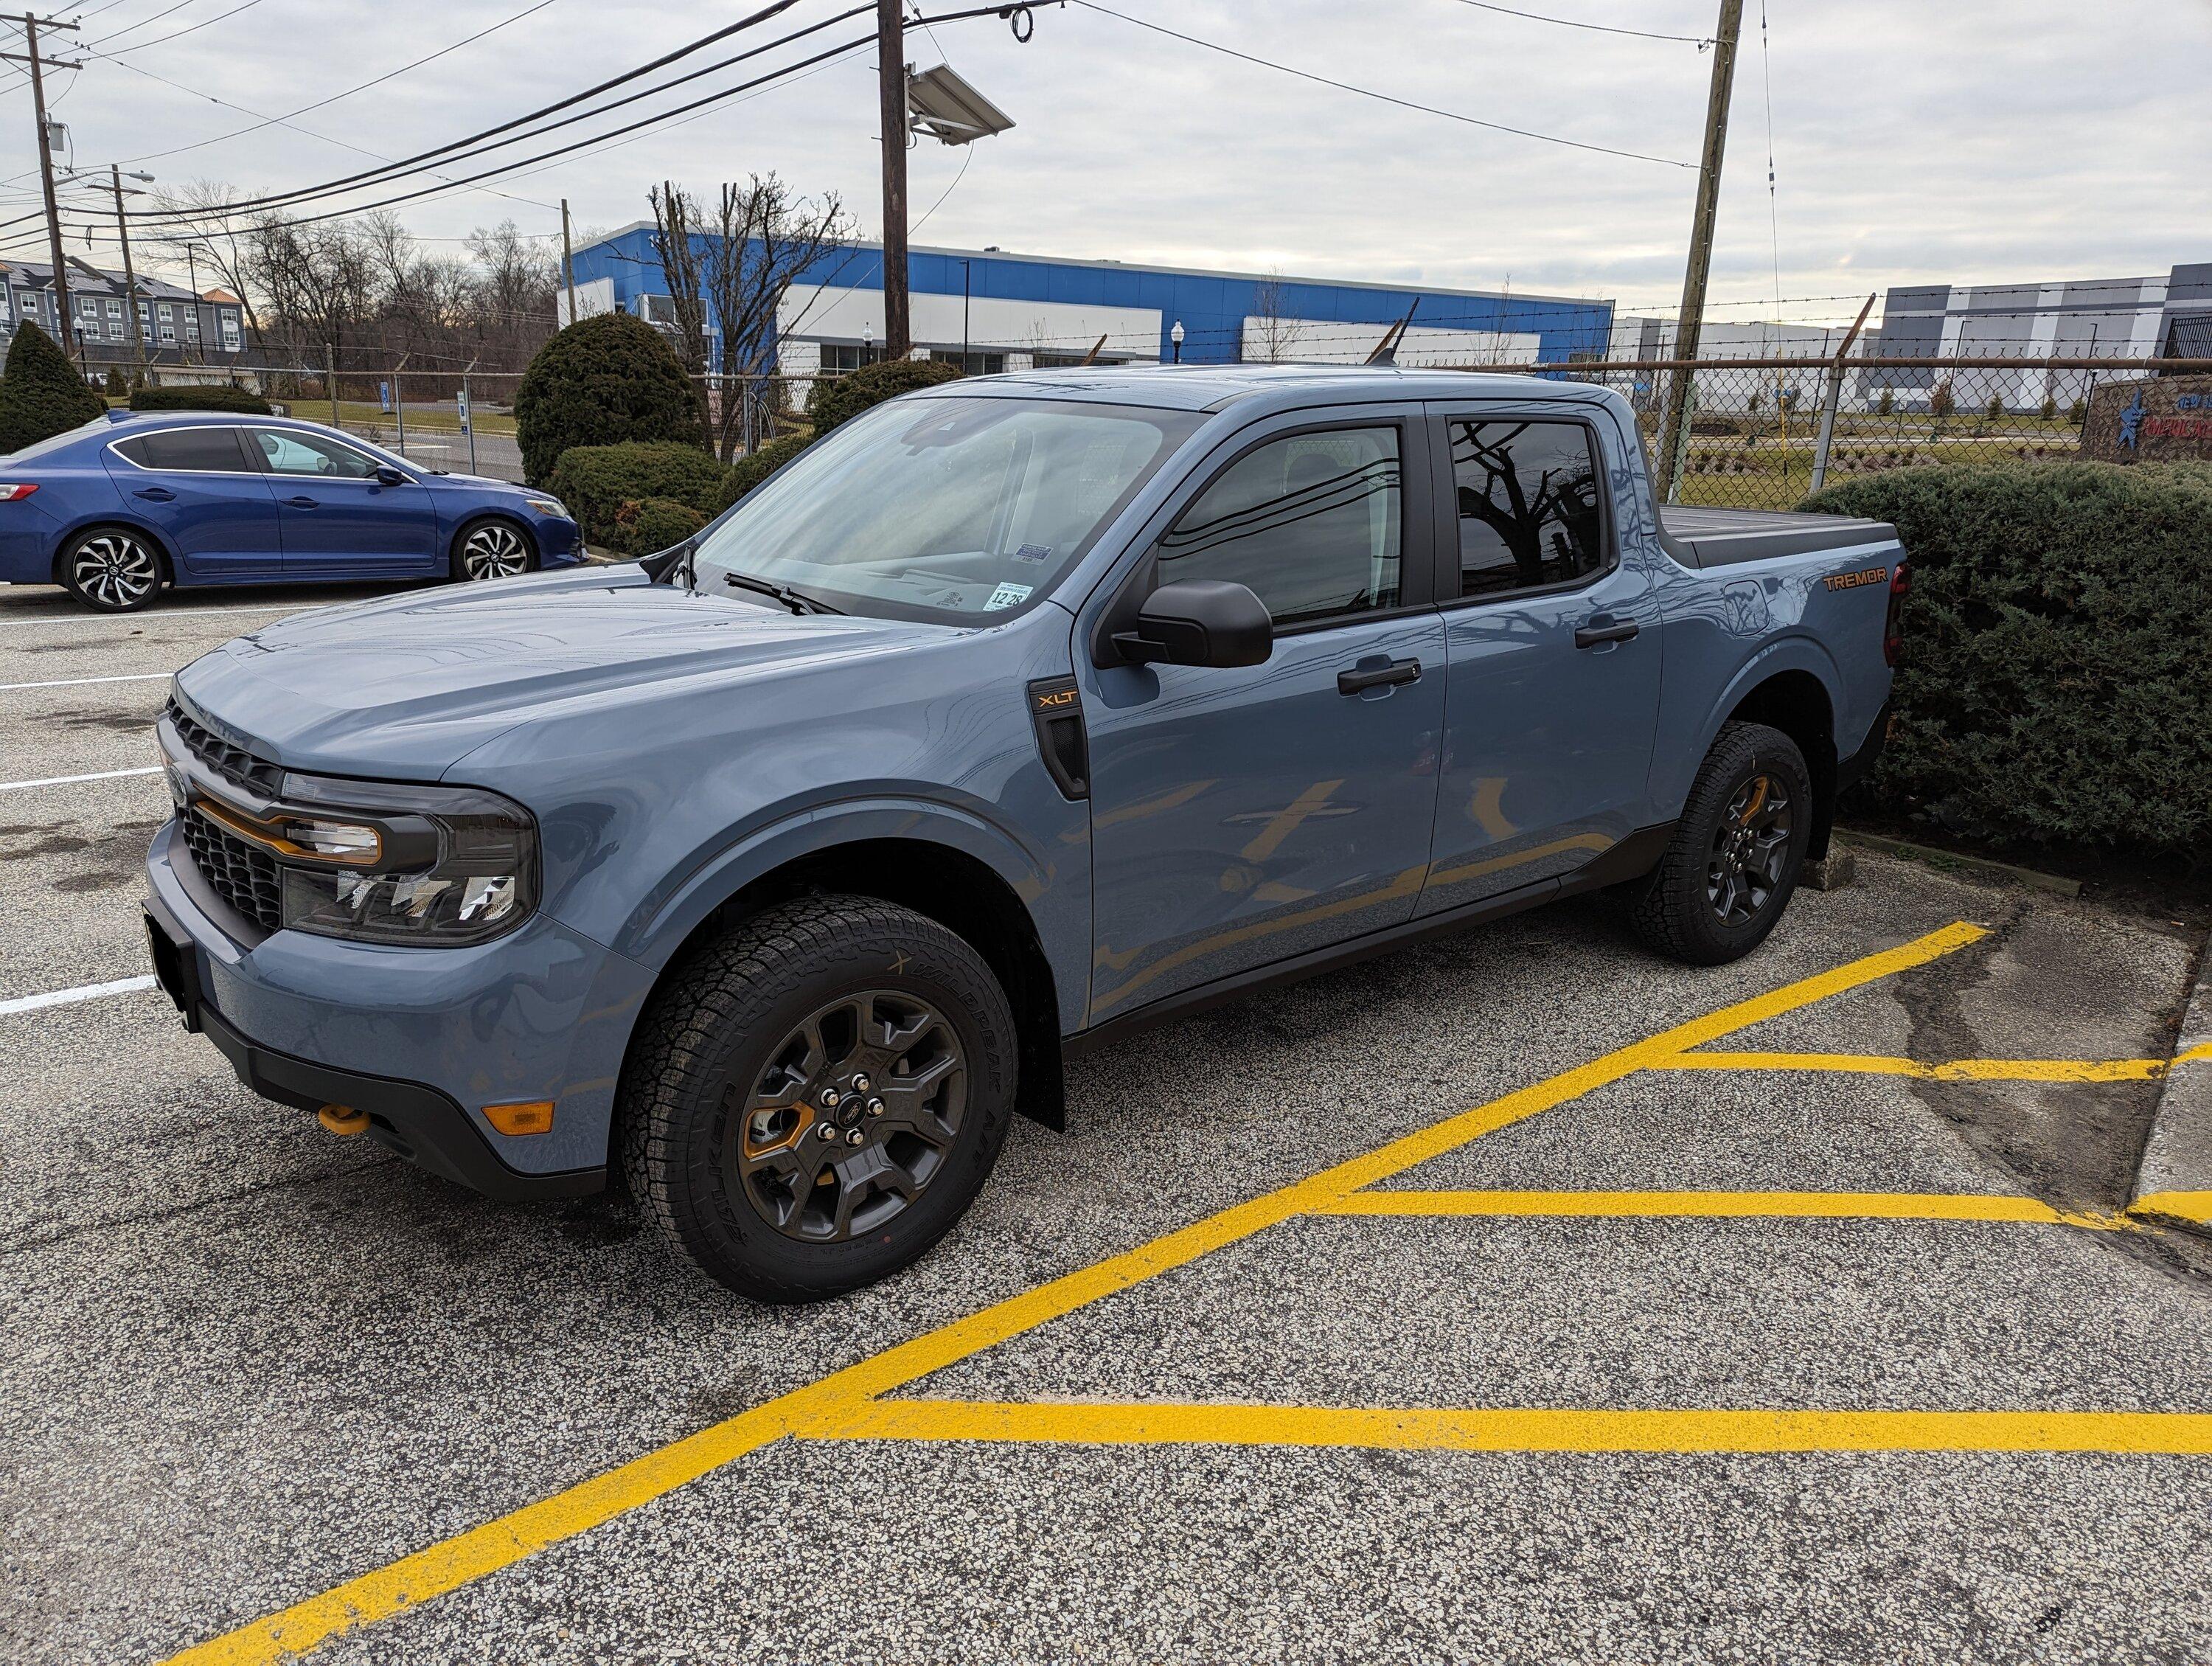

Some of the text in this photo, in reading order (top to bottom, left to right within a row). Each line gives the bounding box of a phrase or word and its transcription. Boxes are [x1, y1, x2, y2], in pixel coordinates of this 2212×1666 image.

[1823, 566, 1888, 592] TREMOR
[992, 591, 1023, 607] 12 28
[1038, 690, 1077, 707] XLT
